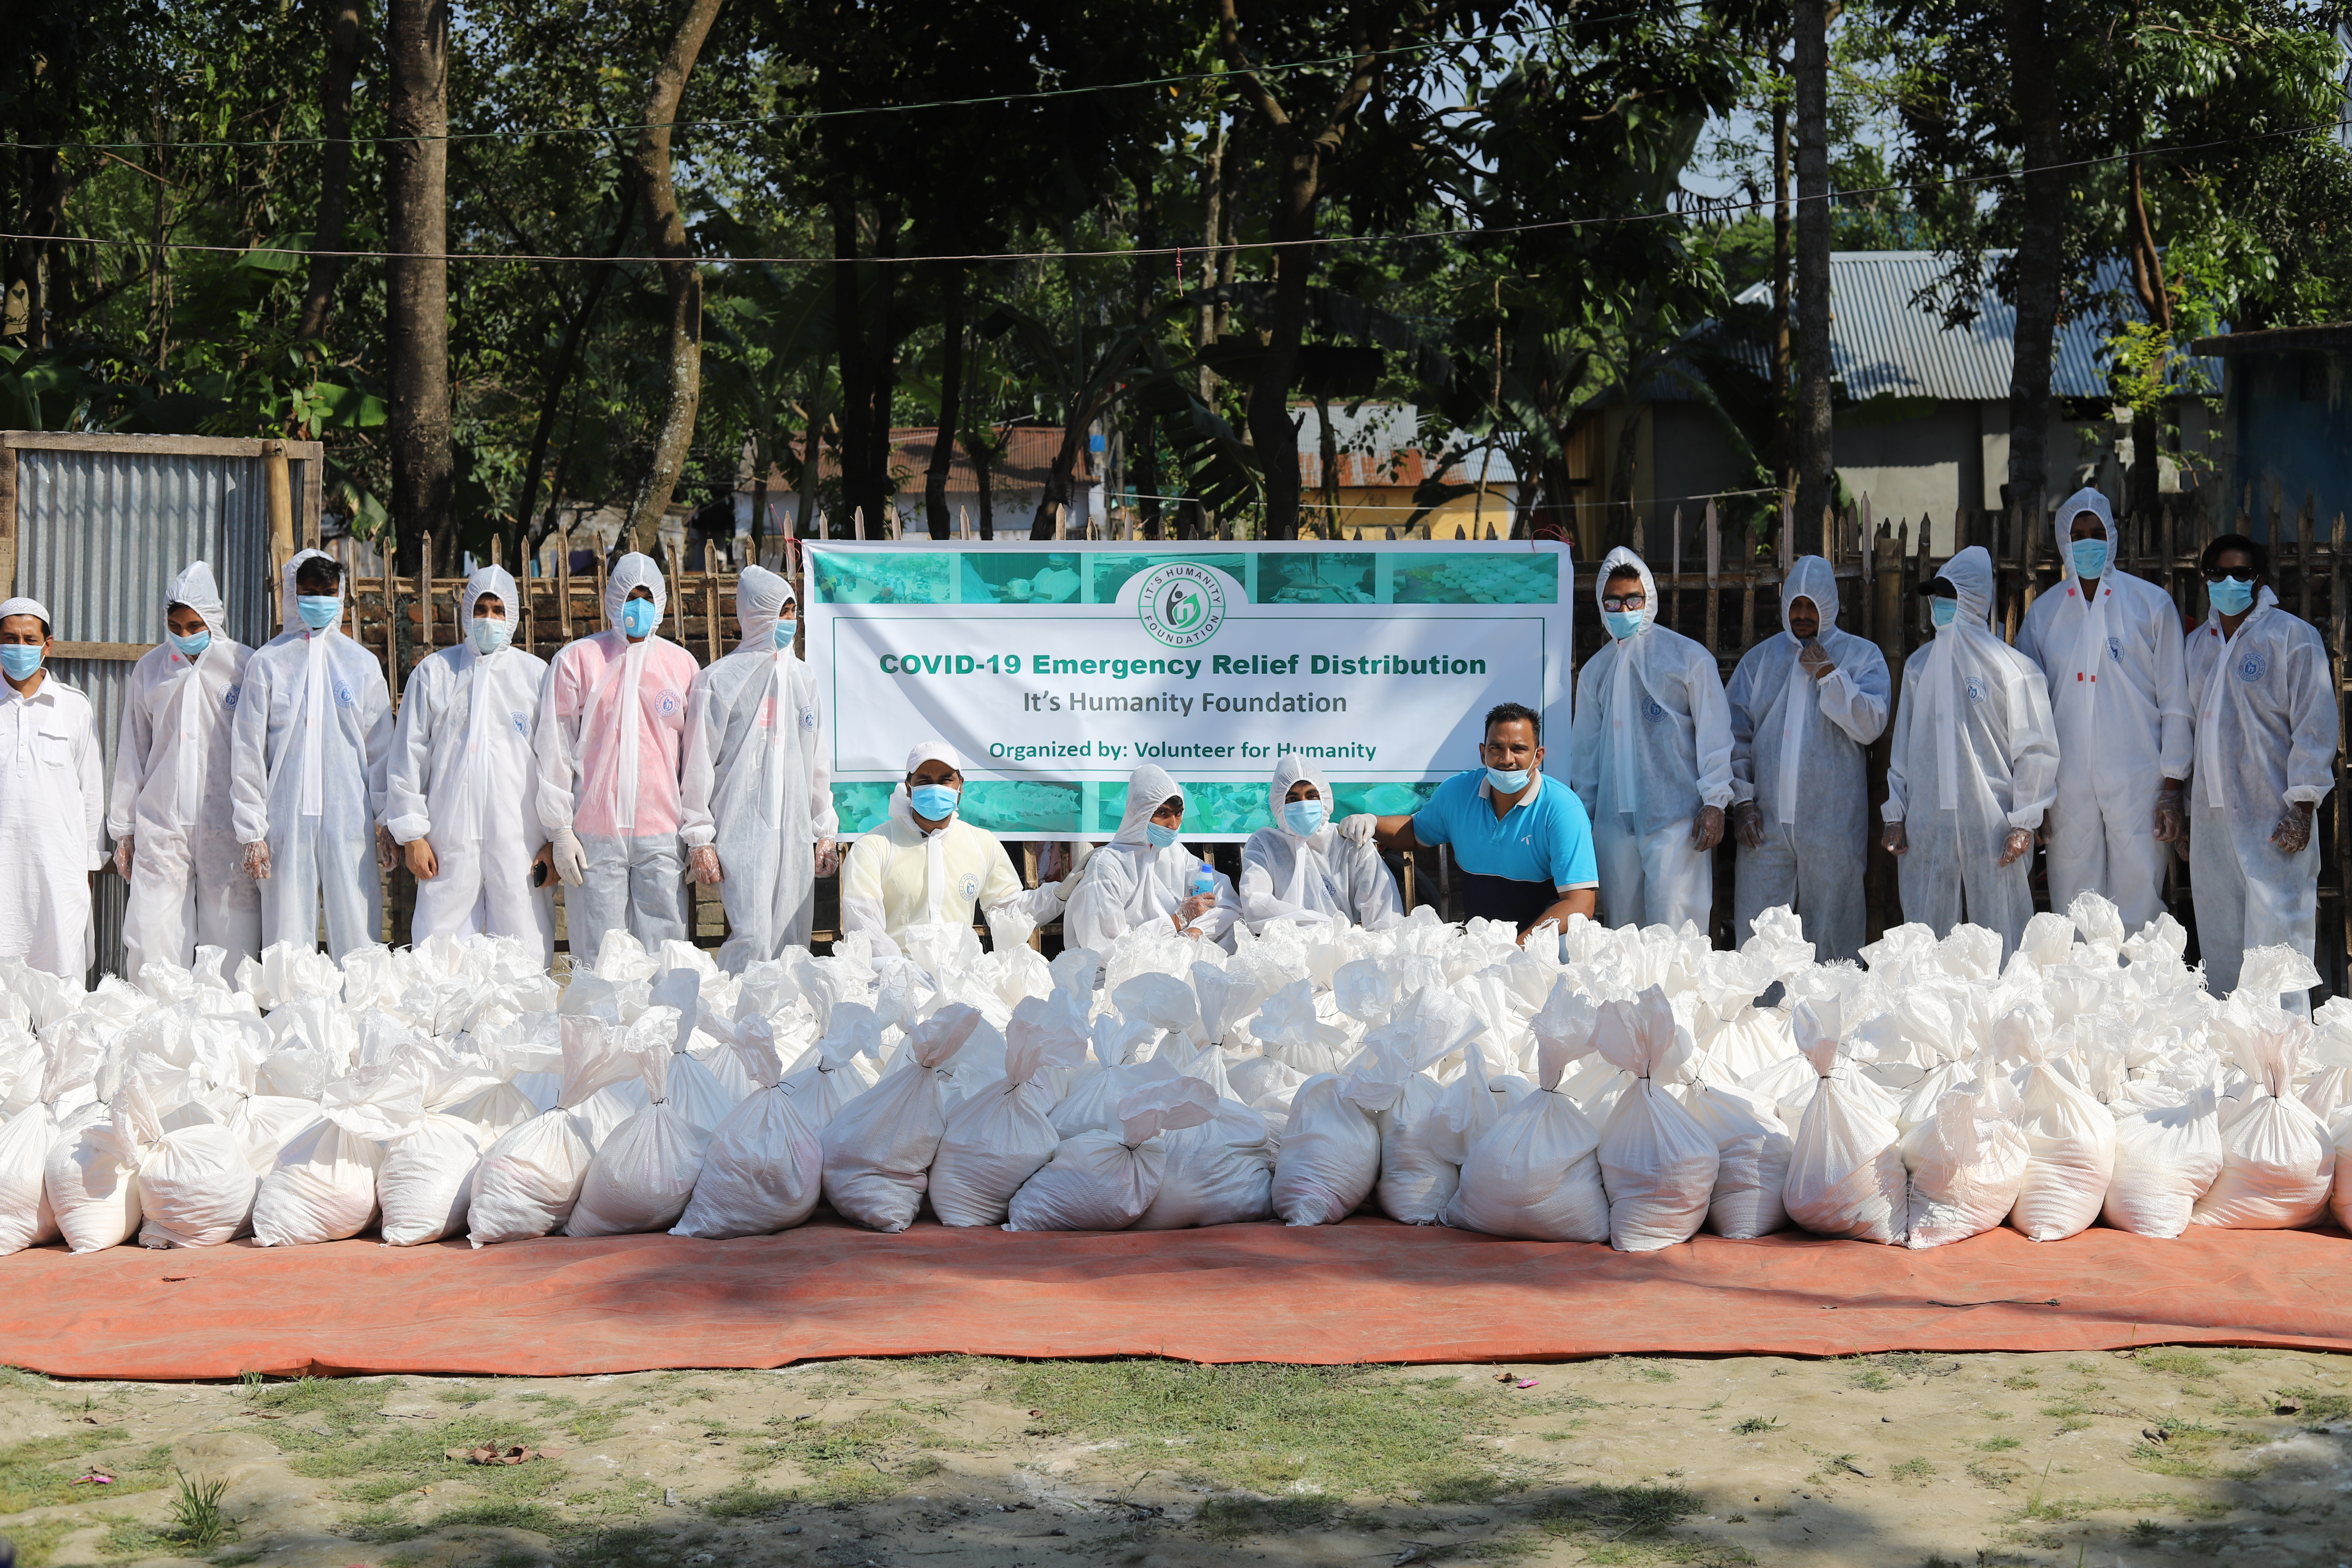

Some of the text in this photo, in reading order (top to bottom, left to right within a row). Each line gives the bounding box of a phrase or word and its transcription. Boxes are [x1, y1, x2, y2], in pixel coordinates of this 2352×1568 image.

[1144, 567, 1221, 603] IT'S HUMANITY
[1144, 616, 1220, 644] FOUNDATION
[879, 654, 1485, 679] COVID-19 Emergency Relief Distribution
[665, 691, 679, 706] HUMANITY
[1024, 691, 1346, 717] It's Humanity Foundation
[513, 713, 529, 727] HUMANITY
[656, 704, 677, 716] FOUNDATION
[989, 741, 1377, 761] Organized by: Volunteer for Humanity
